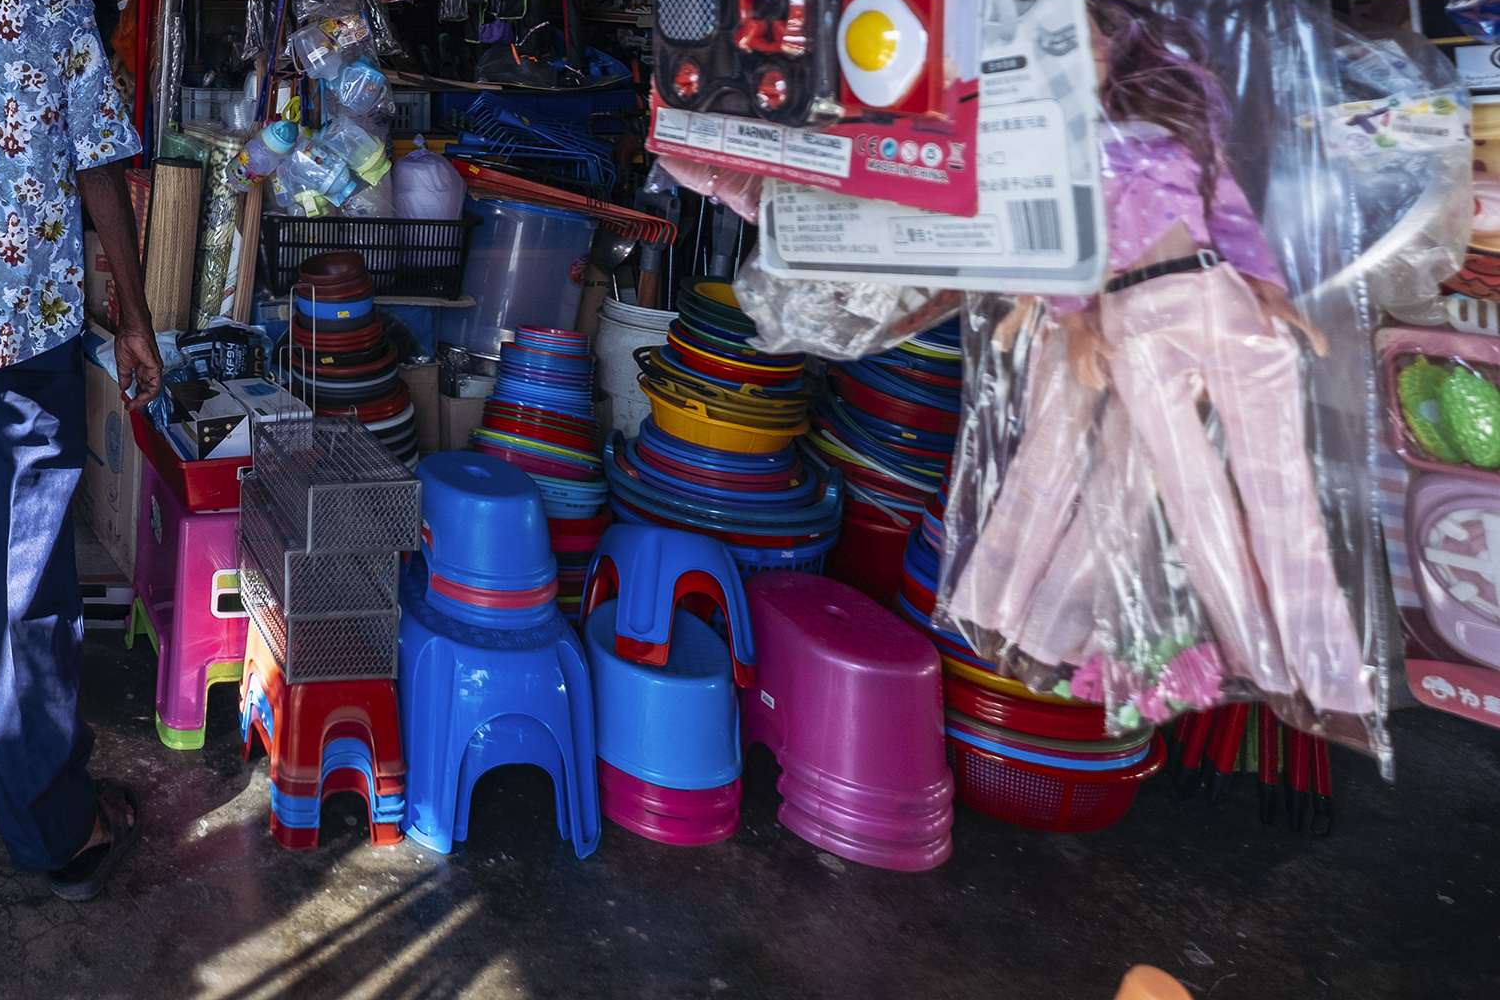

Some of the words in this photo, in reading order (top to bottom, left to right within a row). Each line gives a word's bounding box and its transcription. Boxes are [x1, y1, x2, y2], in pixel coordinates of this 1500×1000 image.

[866, 158, 898, 174] MADE
[899, 162, 910, 175] IN
[910, 164, 949, 184] CHINA
[226, 342, 236, 376] KF94
